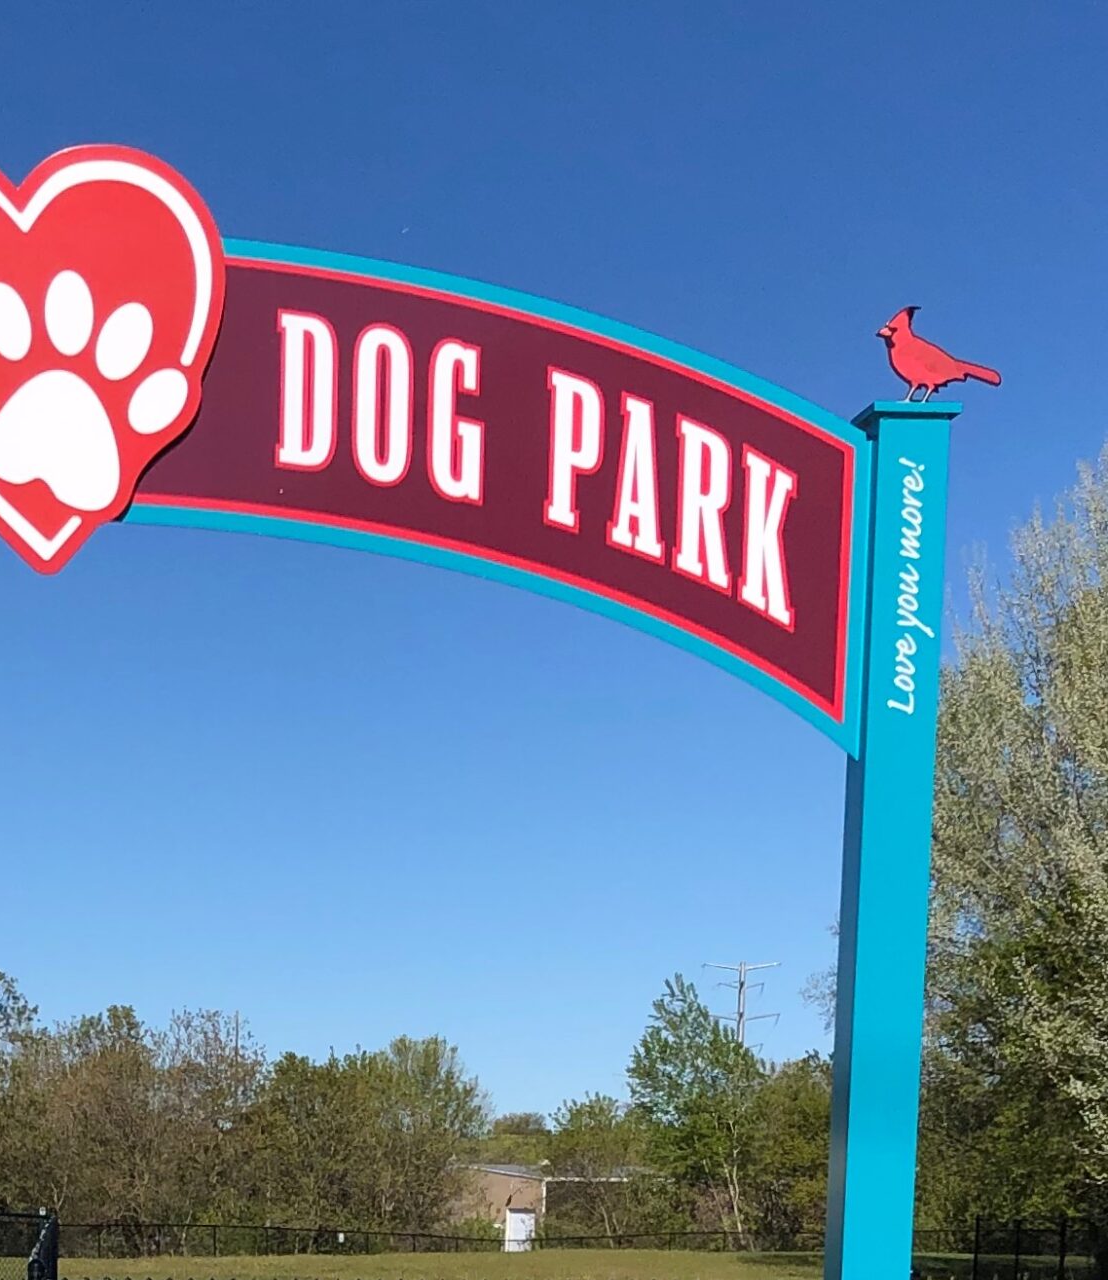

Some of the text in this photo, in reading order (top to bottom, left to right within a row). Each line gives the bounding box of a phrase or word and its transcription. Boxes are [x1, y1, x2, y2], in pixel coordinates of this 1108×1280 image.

[275, 308, 485, 506] DOG
[543, 365, 798, 633] PARK
[887, 457, 935, 715] Love you more!
